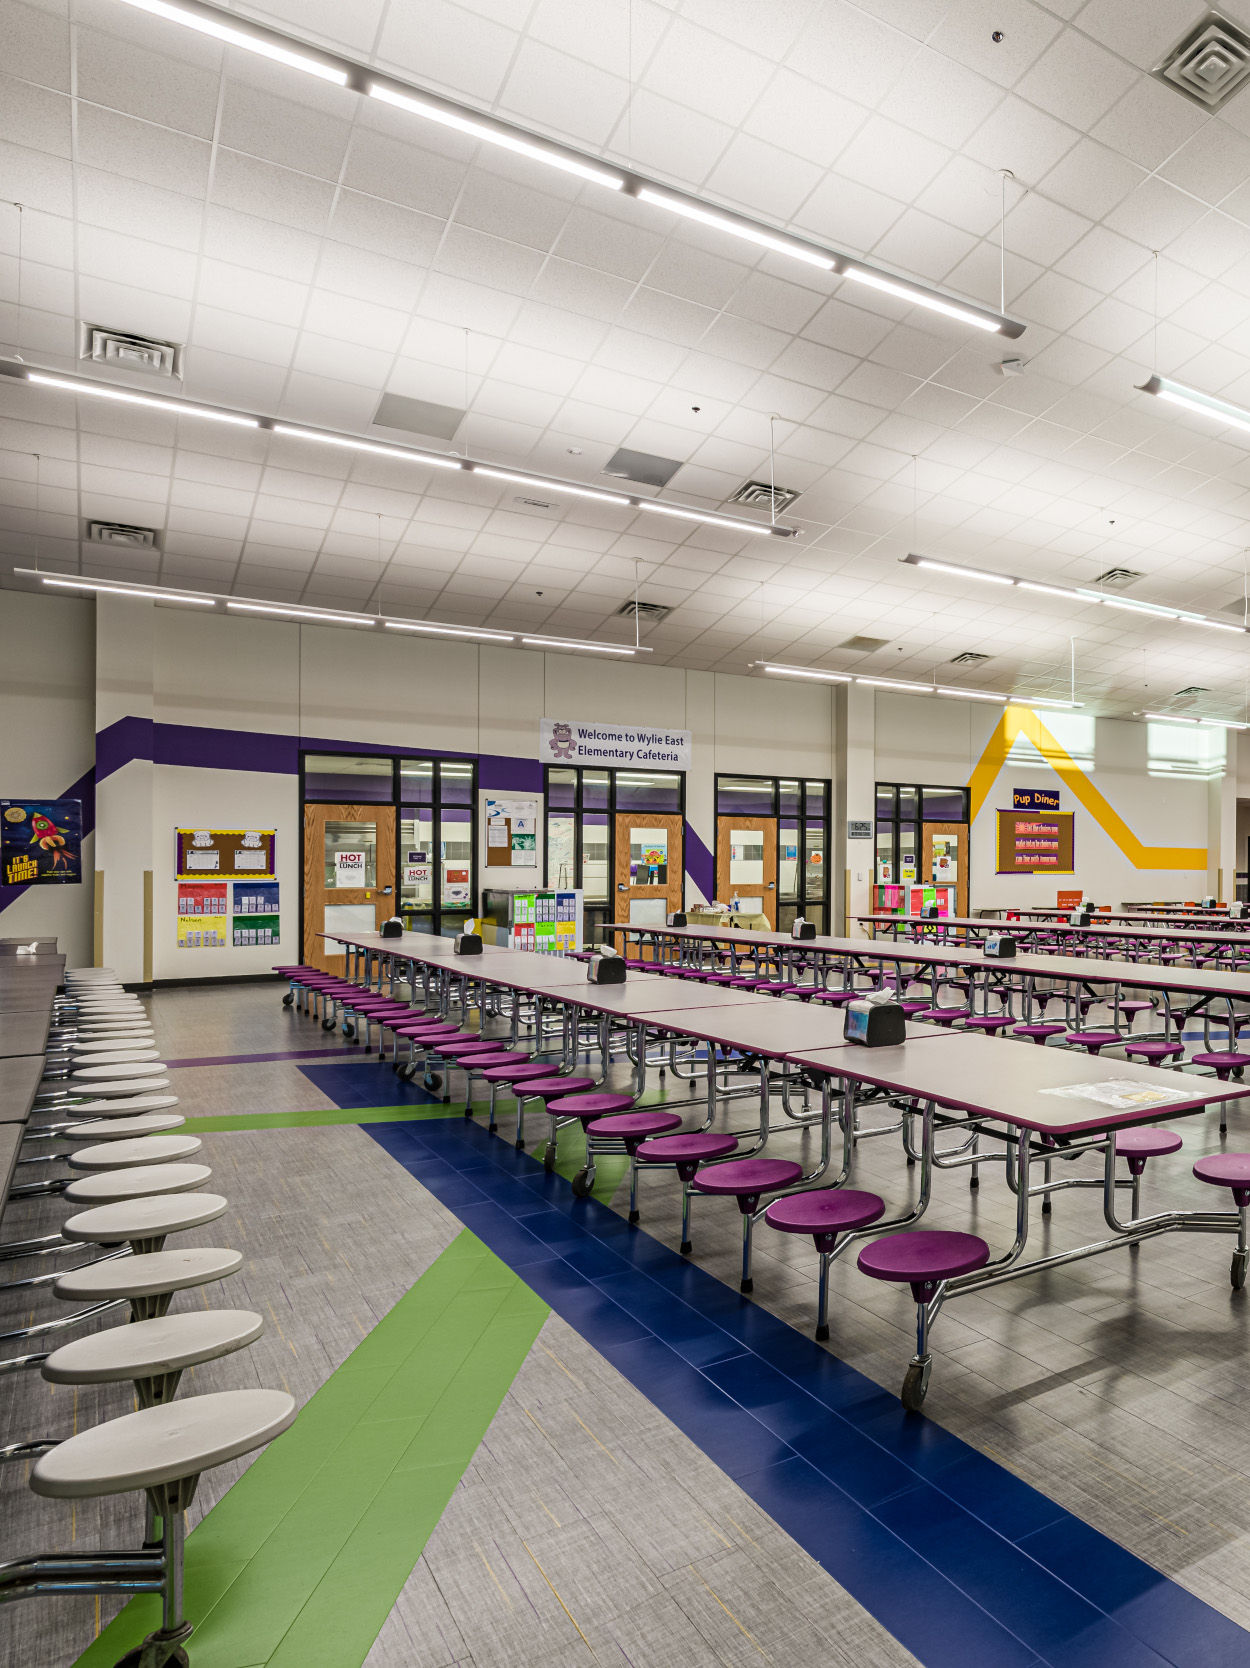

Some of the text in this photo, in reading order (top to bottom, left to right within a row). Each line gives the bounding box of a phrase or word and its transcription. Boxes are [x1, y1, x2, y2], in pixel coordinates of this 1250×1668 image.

[577, 728, 684, 746] Welcome to Wylie East
[578, 745, 679, 761] Elementary Cafeteria
[1013, 792, 1060, 806] Pup Diner
[12, 854, 29, 865] IT'S
[340, 854, 362, 862] HOT
[6, 859, 38, 875] LAUNCH
[8, 867, 38, 884] TIME!
